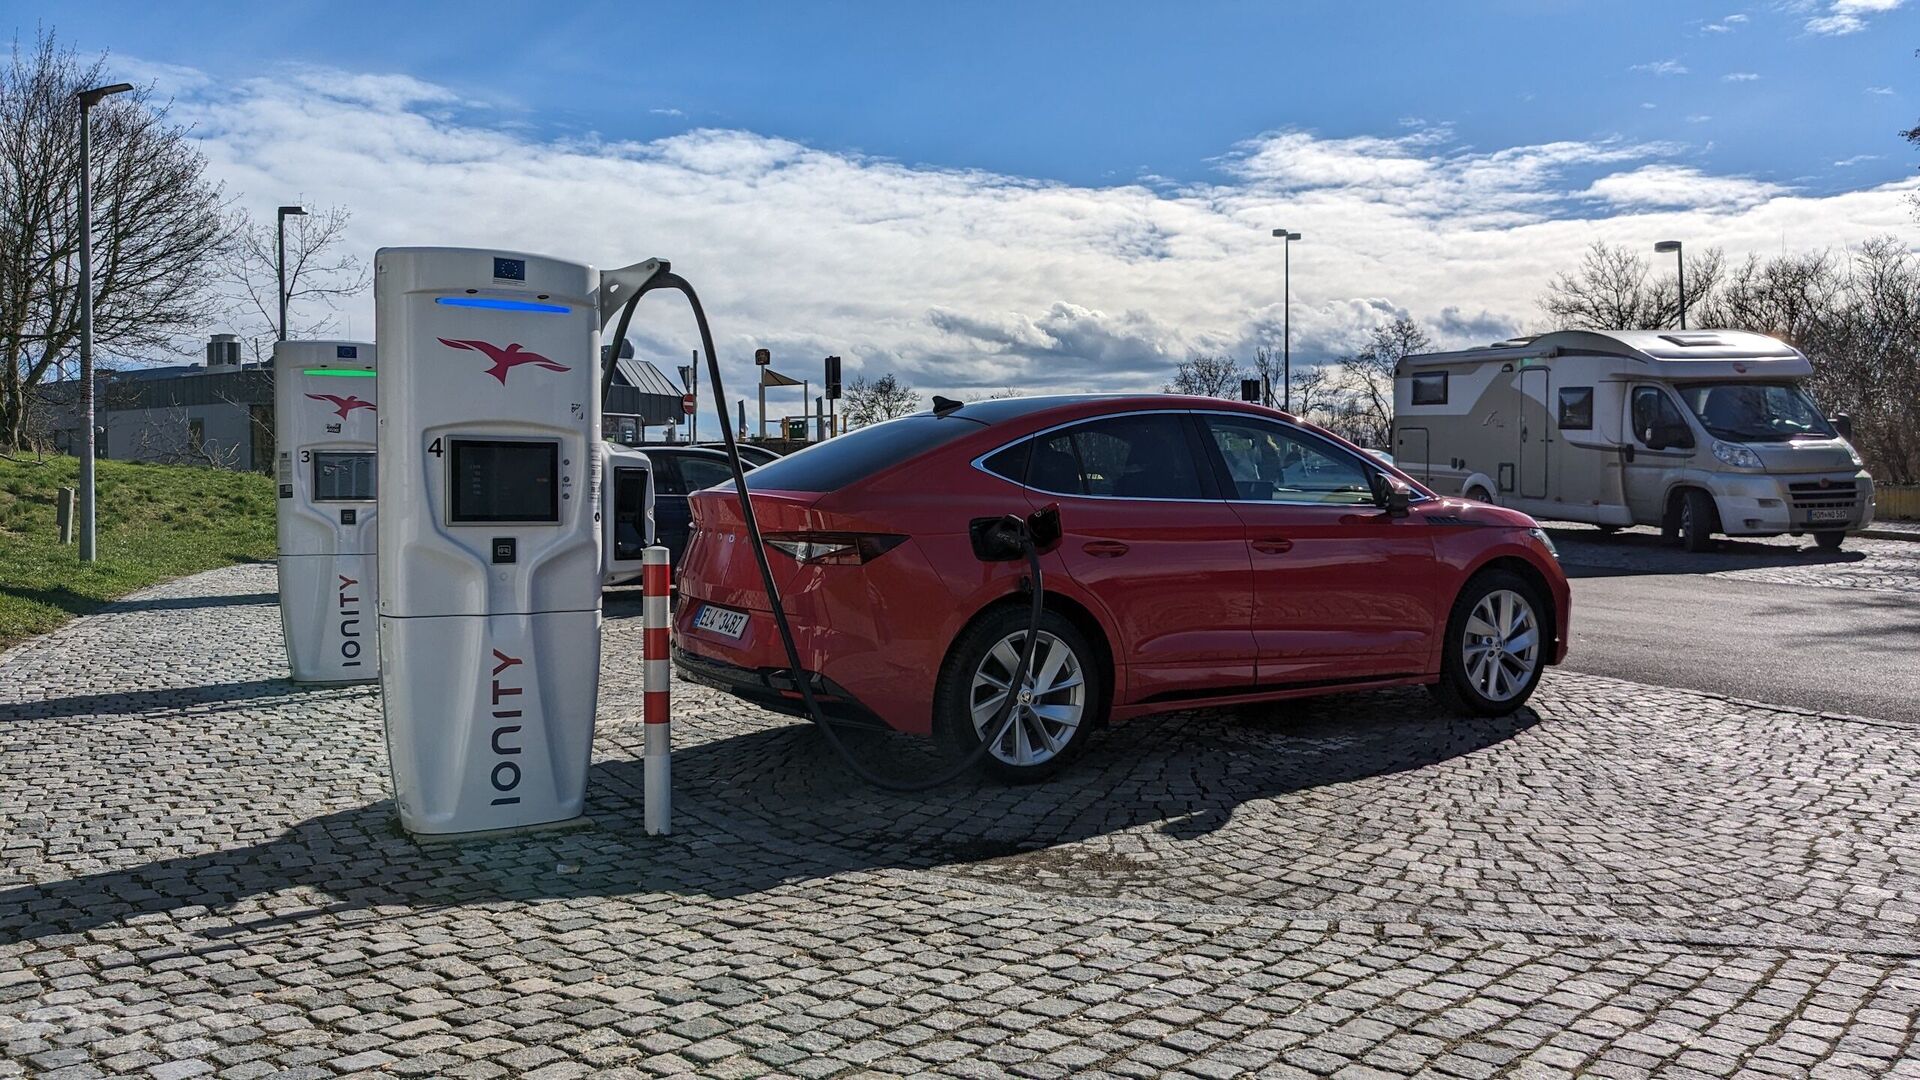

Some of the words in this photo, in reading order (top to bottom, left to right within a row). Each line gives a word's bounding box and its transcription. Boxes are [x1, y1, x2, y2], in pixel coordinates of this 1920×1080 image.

[301, 451, 310, 463] 3
[427, 438, 444, 458] 4
[339, 574, 361, 667] IONITY
[699, 607, 719, 628] EL4
[490, 648, 523, 806] IONITY
